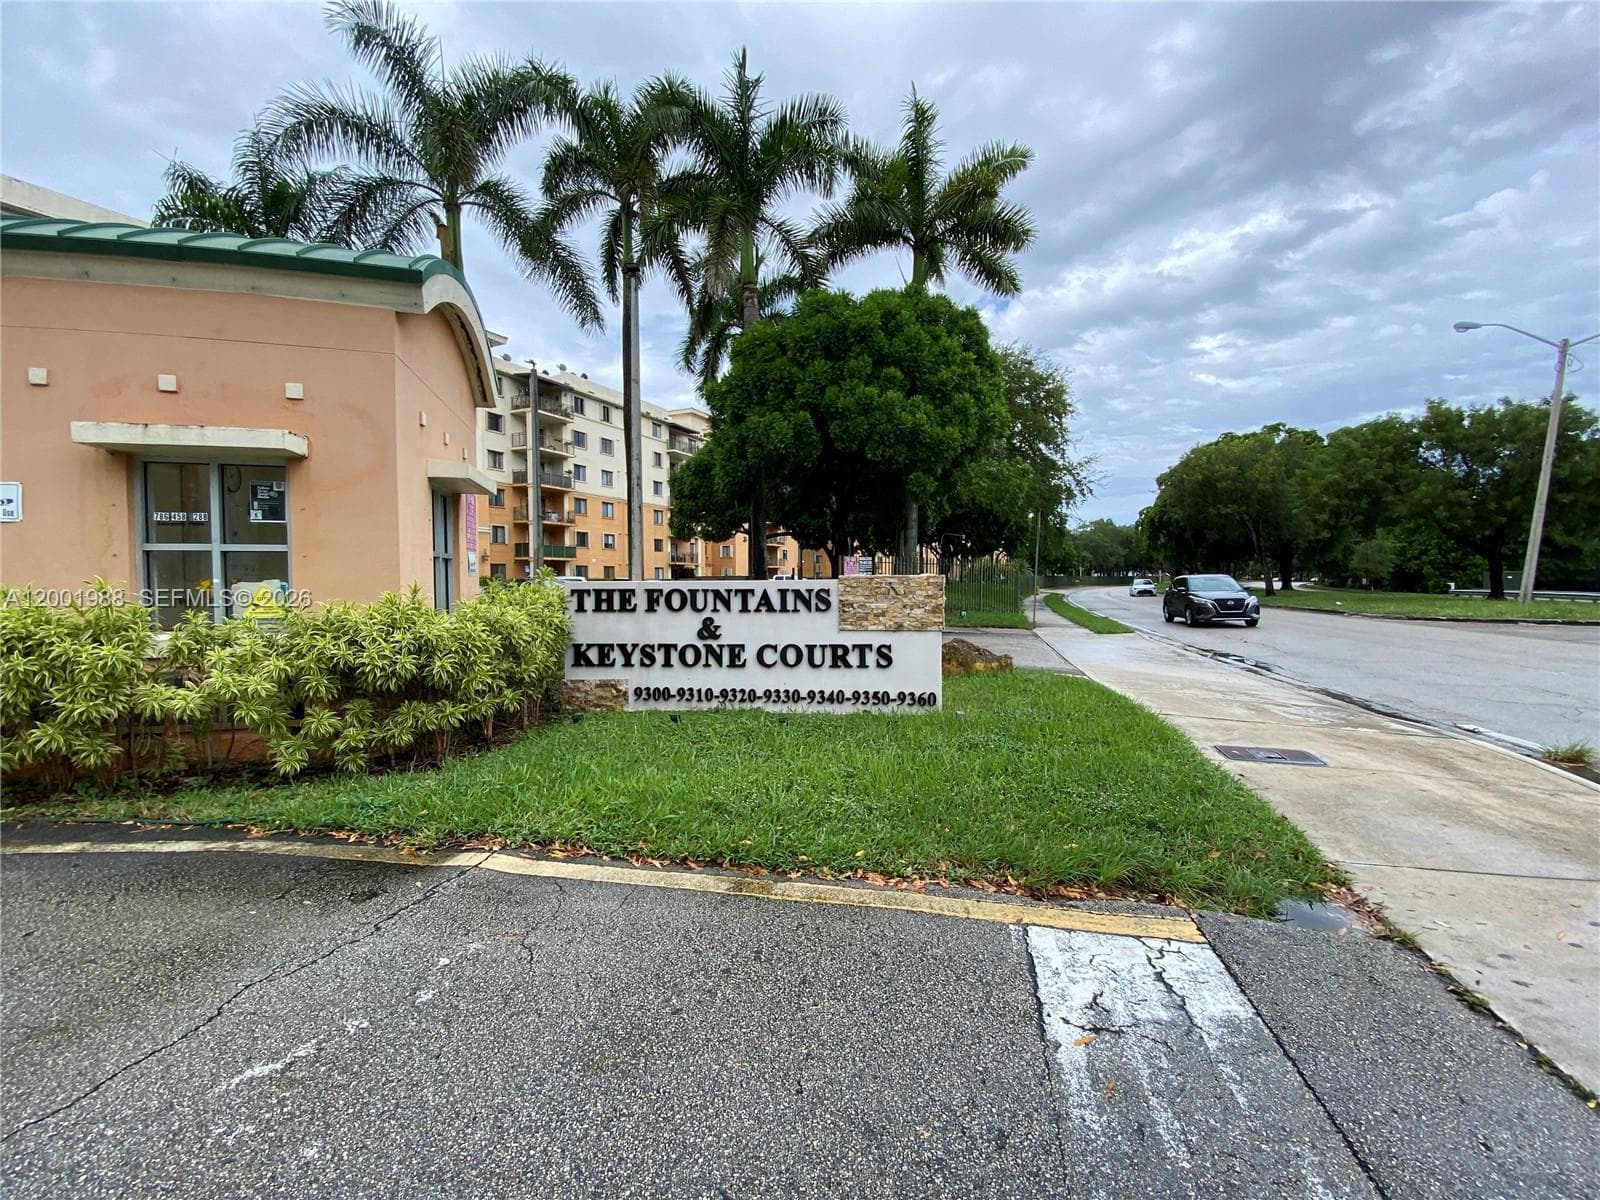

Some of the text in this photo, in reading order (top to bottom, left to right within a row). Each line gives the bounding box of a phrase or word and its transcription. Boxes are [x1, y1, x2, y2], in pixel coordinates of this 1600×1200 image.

[570, 588, 832, 613] THE FOUNTAINS
[697, 617, 722, 640] &
[571, 643, 894, 669] KEYSTONE COURTS
[633, 686, 937, 707] 9300-9310-9320-9330-9340-9350-9360
